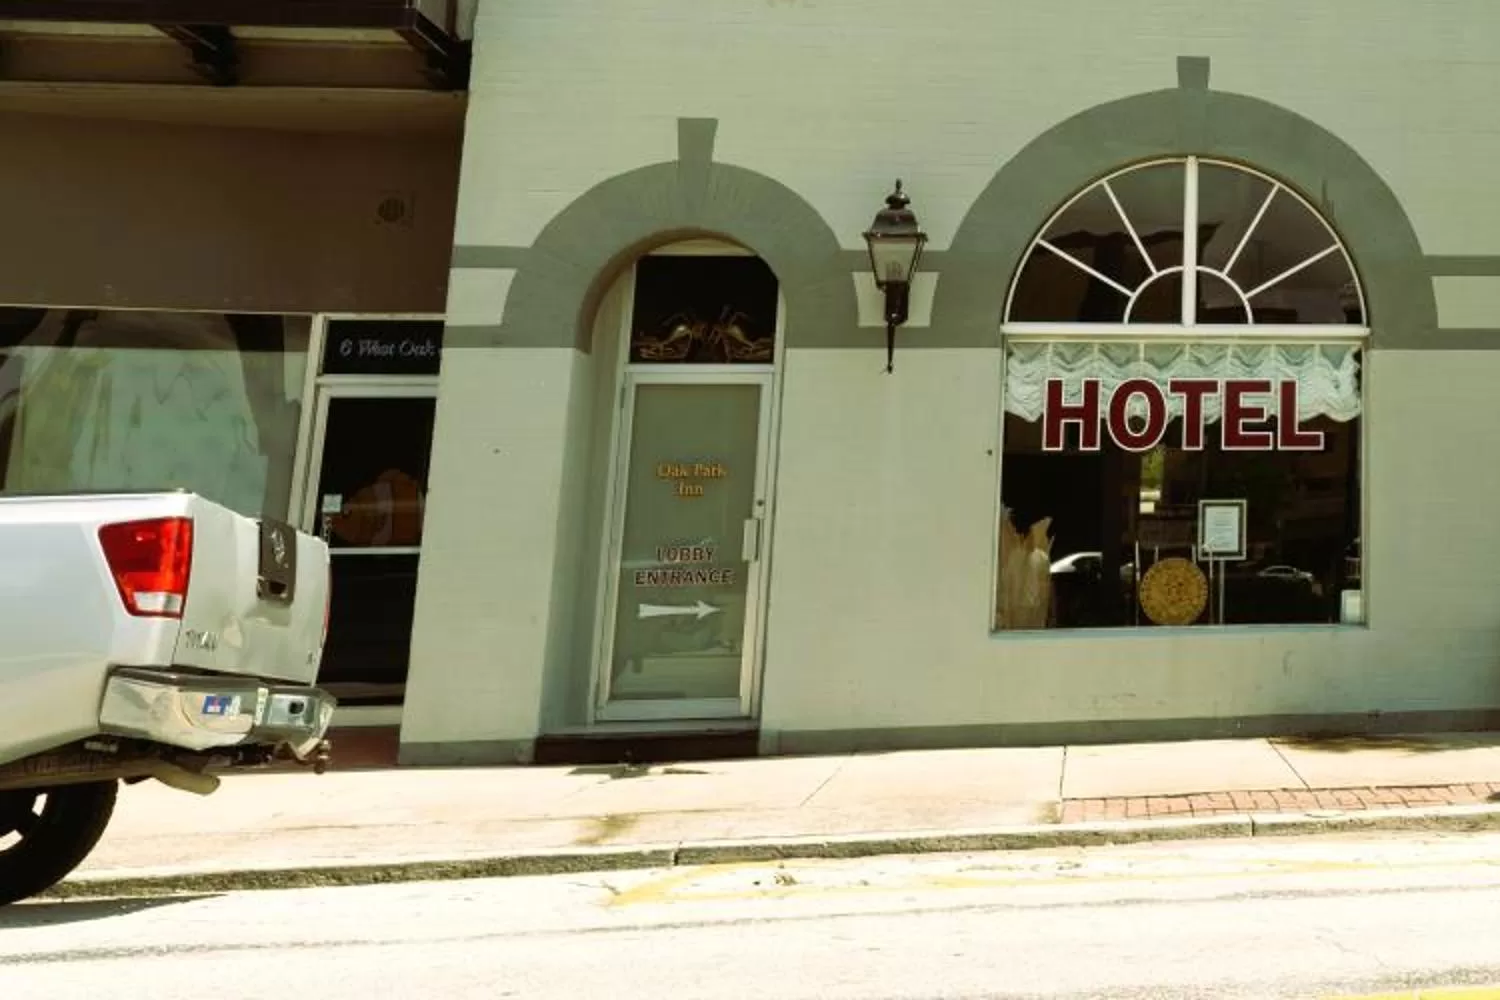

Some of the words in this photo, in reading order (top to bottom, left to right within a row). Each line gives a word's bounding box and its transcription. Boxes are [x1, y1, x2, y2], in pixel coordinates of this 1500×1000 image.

[340, 338, 353, 357] 6
[1042, 377, 1324, 451] HOTEL
[656, 463, 689, 479] Oak
[656, 546, 715, 562] LOBBY
[635, 568, 735, 586] ENTRANCE
